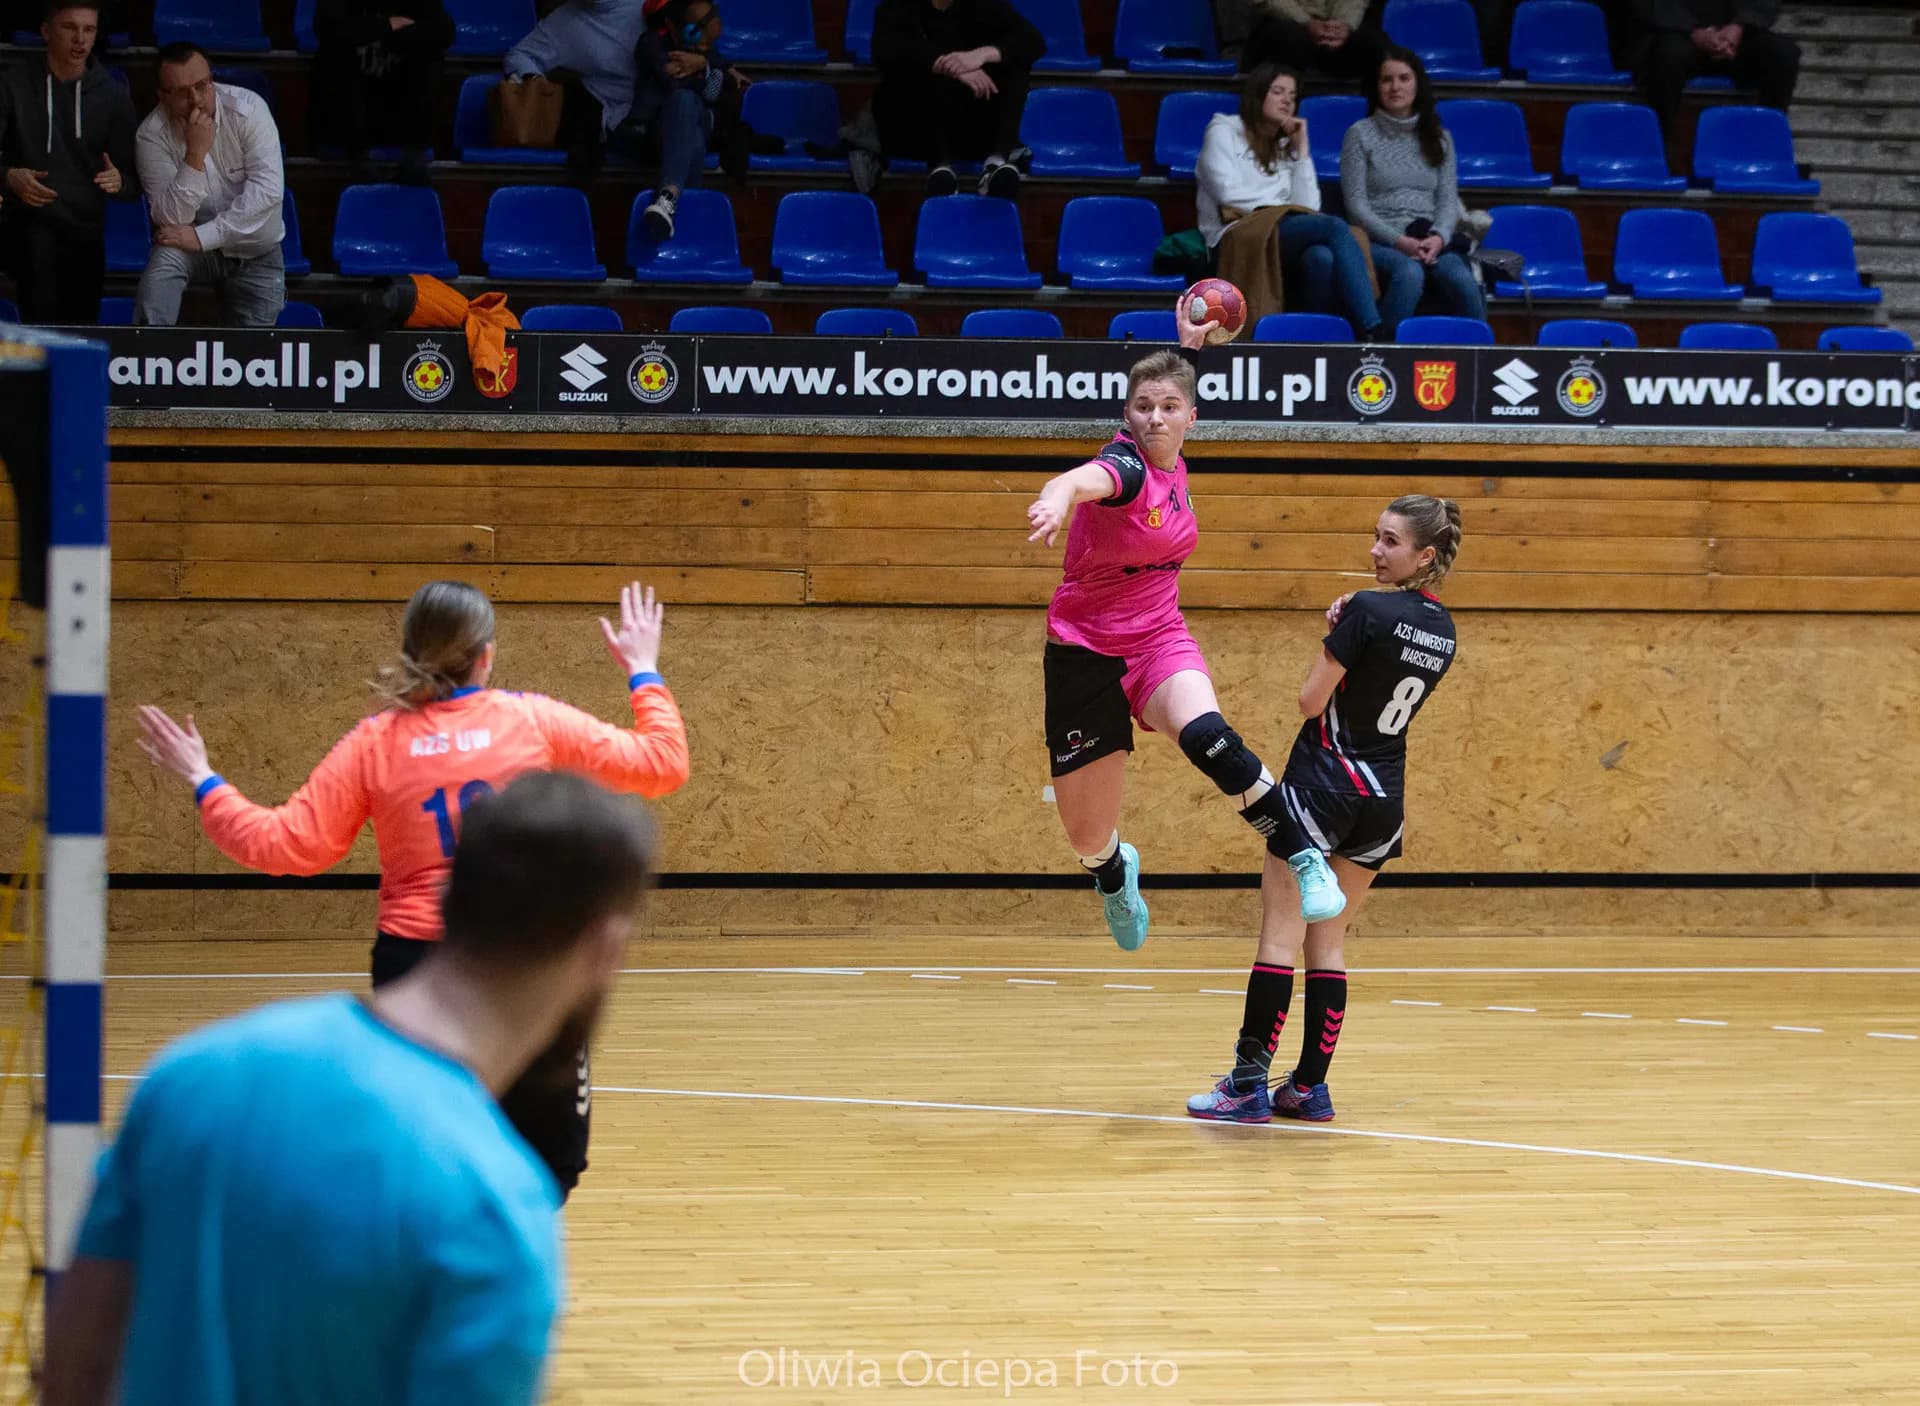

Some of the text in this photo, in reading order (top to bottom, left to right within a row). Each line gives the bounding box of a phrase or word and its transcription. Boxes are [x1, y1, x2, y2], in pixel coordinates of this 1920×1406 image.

[107, 340, 381, 403] andball.pl
[702, 350, 1328, 417] www.koronahanall.pl
[558, 392, 609, 402] SUZUKI
[1418, 381, 1448, 406] CK
[1491, 405, 1540, 416] SUZUKI
[1393, 621, 1414, 641] AZS
[1376, 675, 1426, 736] 8
[409, 728, 492, 758] AZS UW
[421, 778, 495, 859] 1
